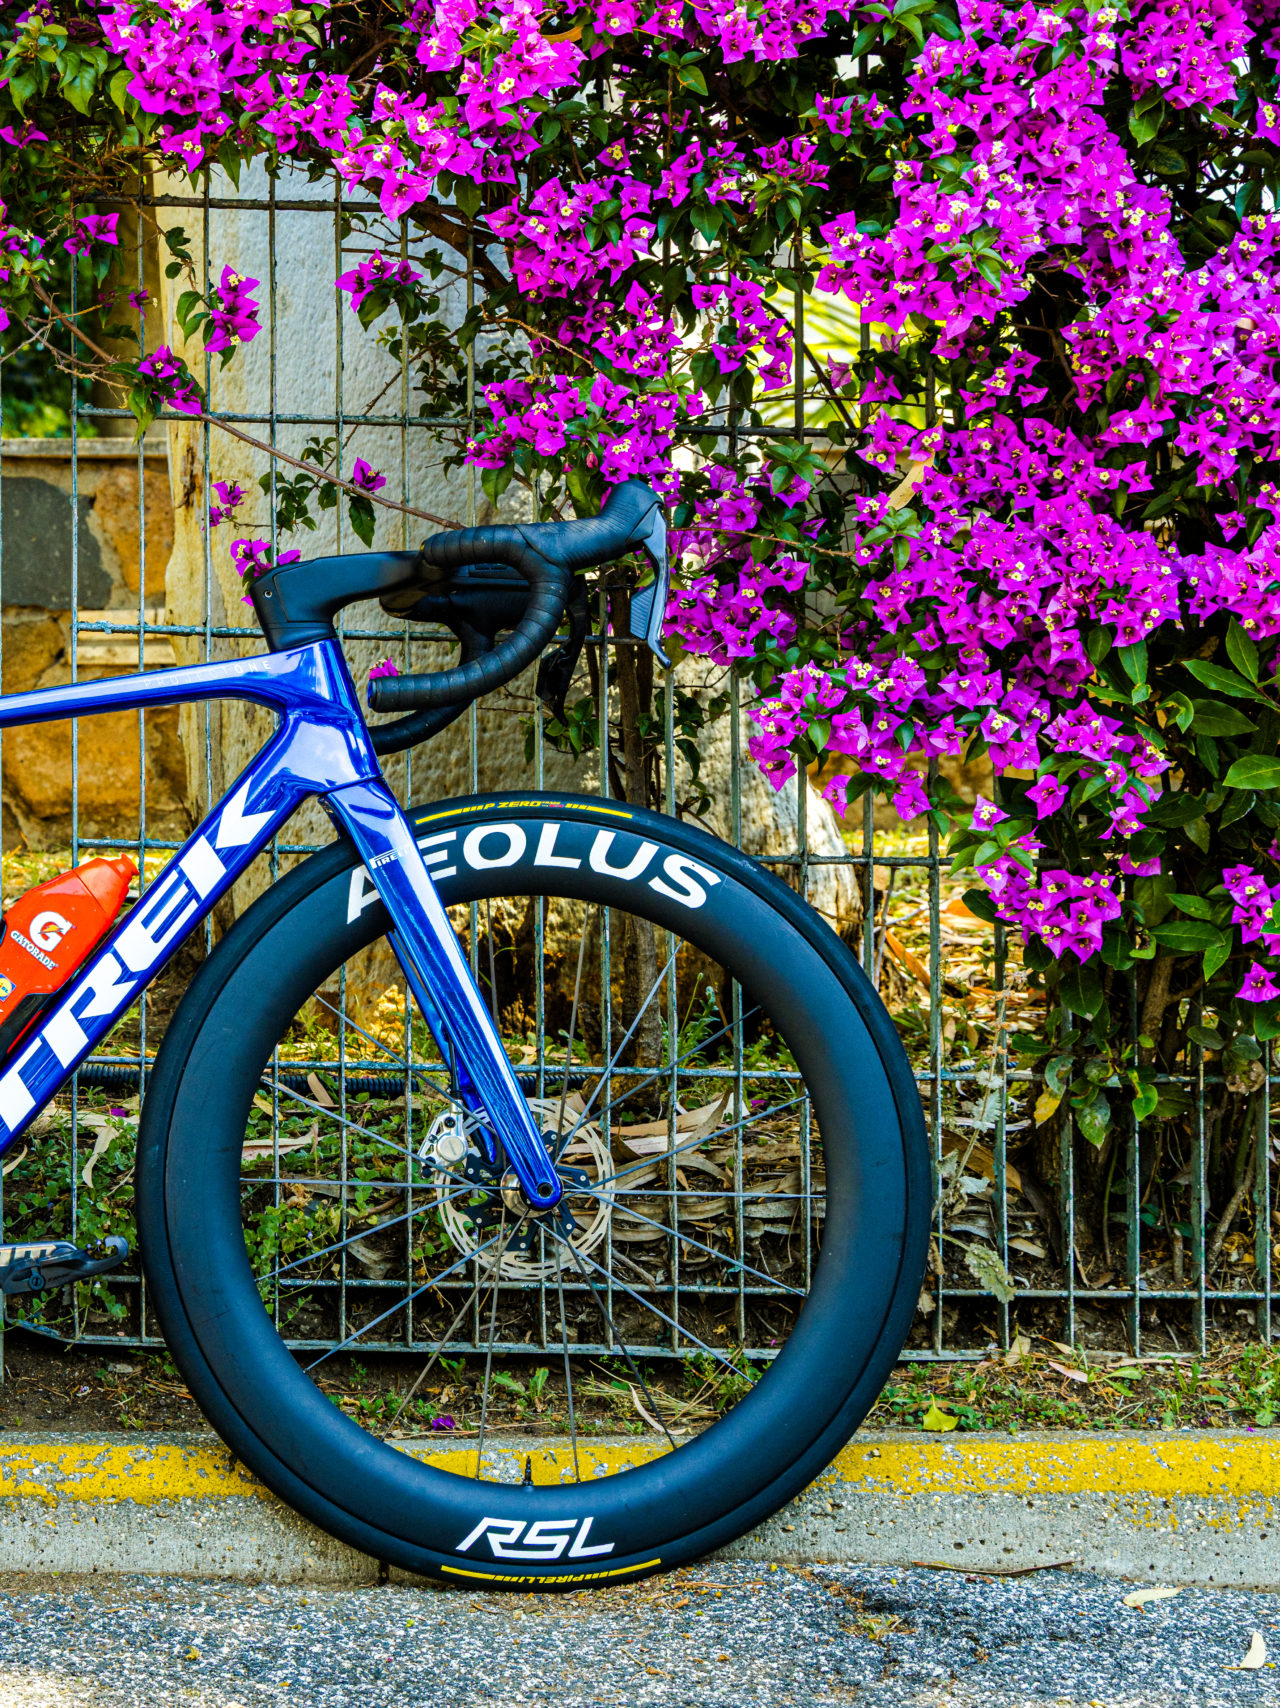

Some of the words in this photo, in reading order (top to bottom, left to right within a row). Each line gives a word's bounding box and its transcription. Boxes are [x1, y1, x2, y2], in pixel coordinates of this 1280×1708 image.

[484, 802, 495, 810] P
[346, 822, 722, 925] AEOLUS
[10, 930, 56, 971] GATORADE
[29, 910, 73, 952] G
[455, 1517, 615, 1560] RSL
[518, 1574, 584, 1584] PIRELLI
